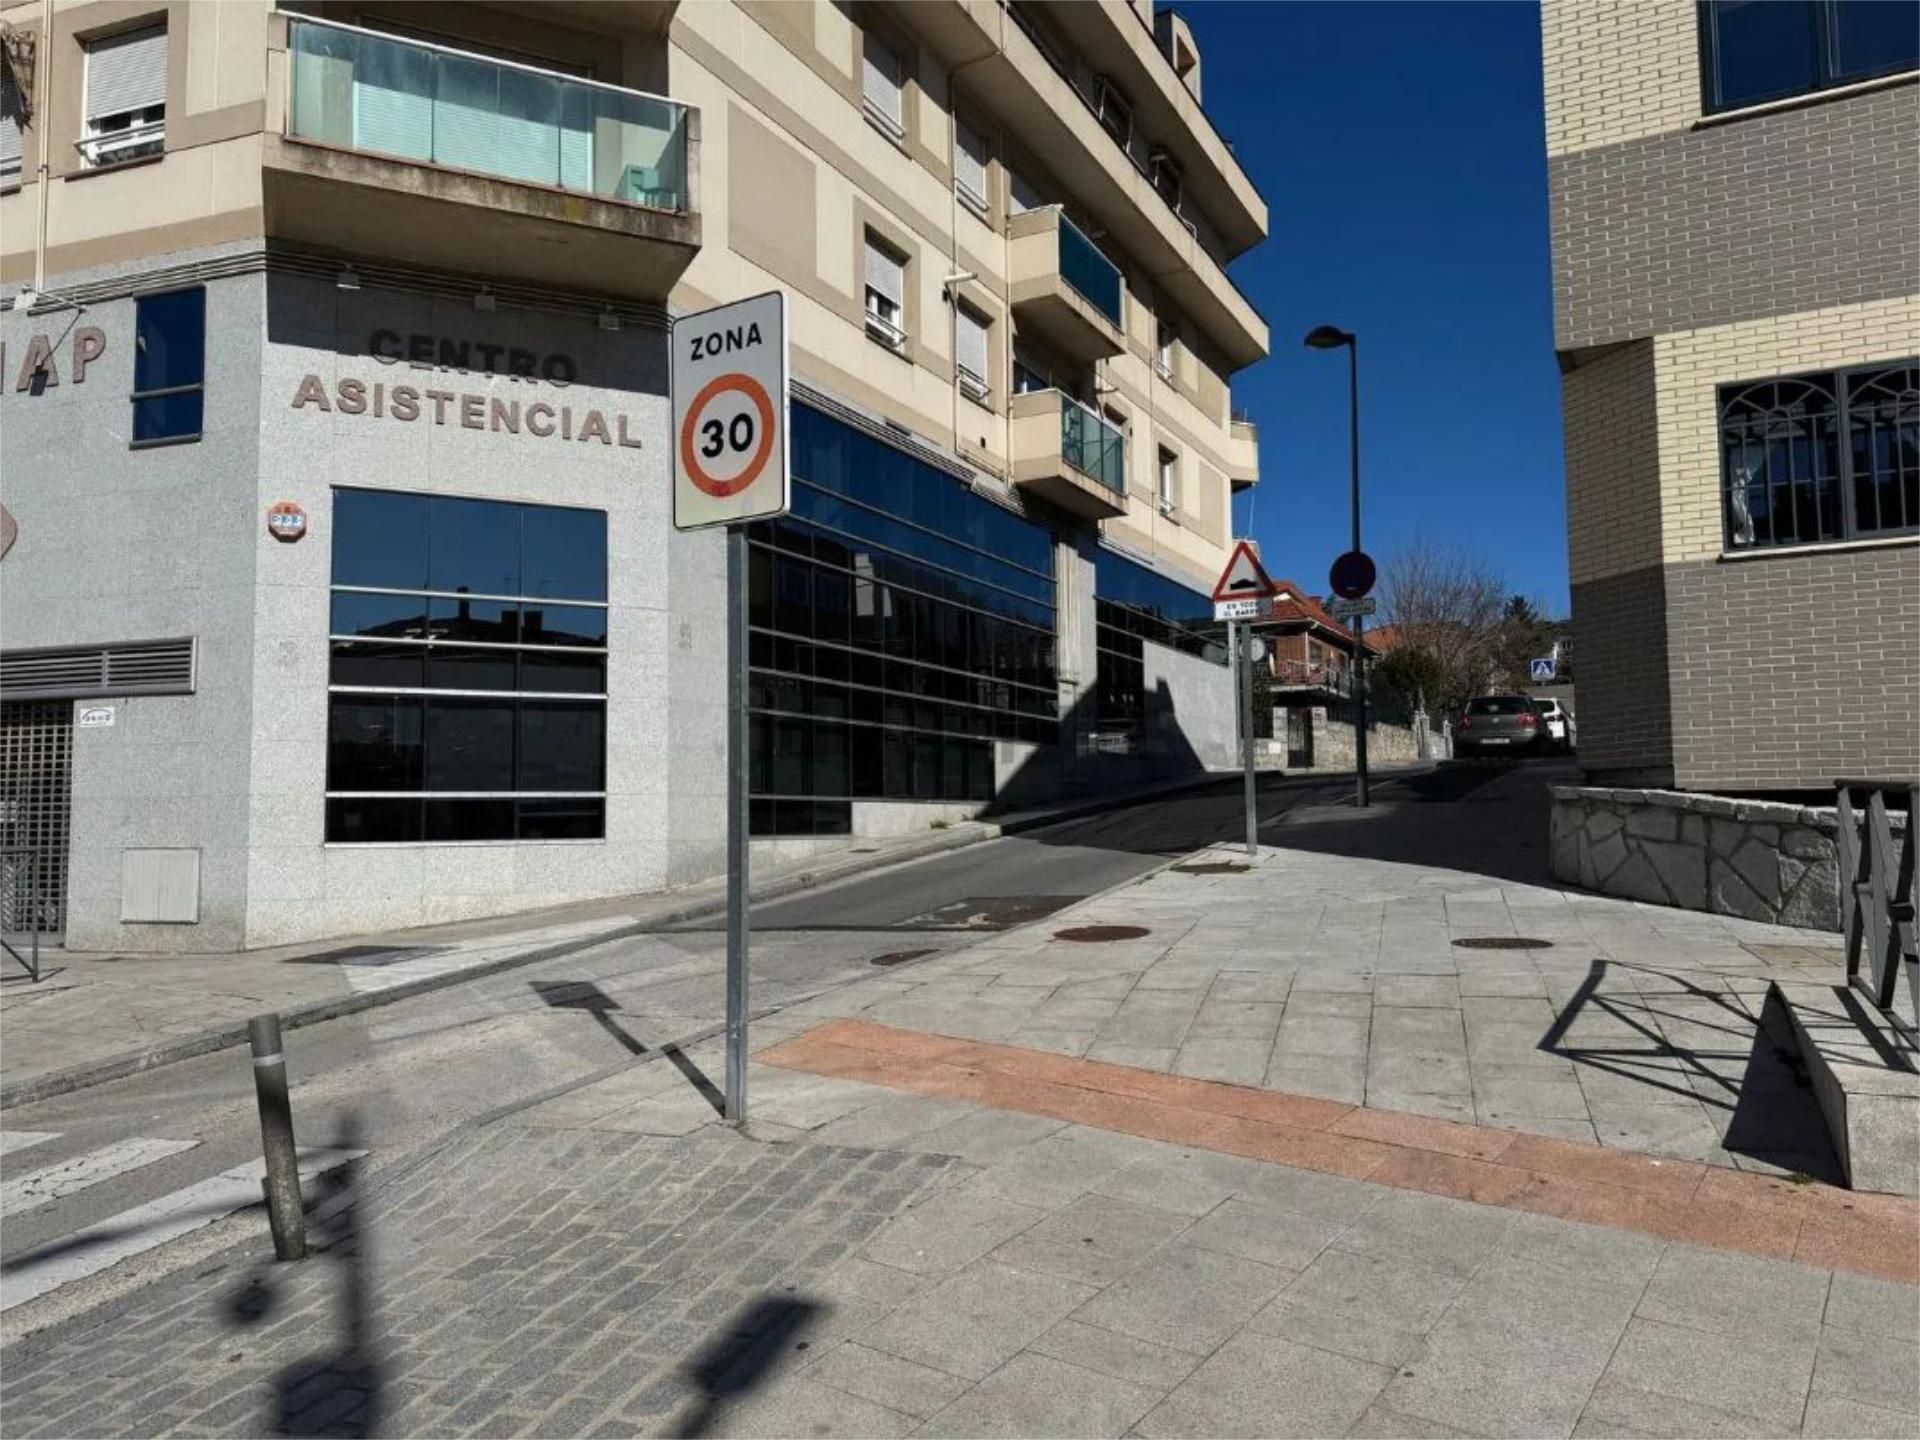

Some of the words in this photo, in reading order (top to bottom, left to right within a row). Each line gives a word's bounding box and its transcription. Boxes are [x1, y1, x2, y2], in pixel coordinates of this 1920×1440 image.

[0, 327, 107, 395] AP
[369, 328, 577, 387] CENTRO
[691, 322, 762, 361] ZONA
[292, 374, 642, 449] ASISTENCIAL
[701, 413, 754, 458] 30
